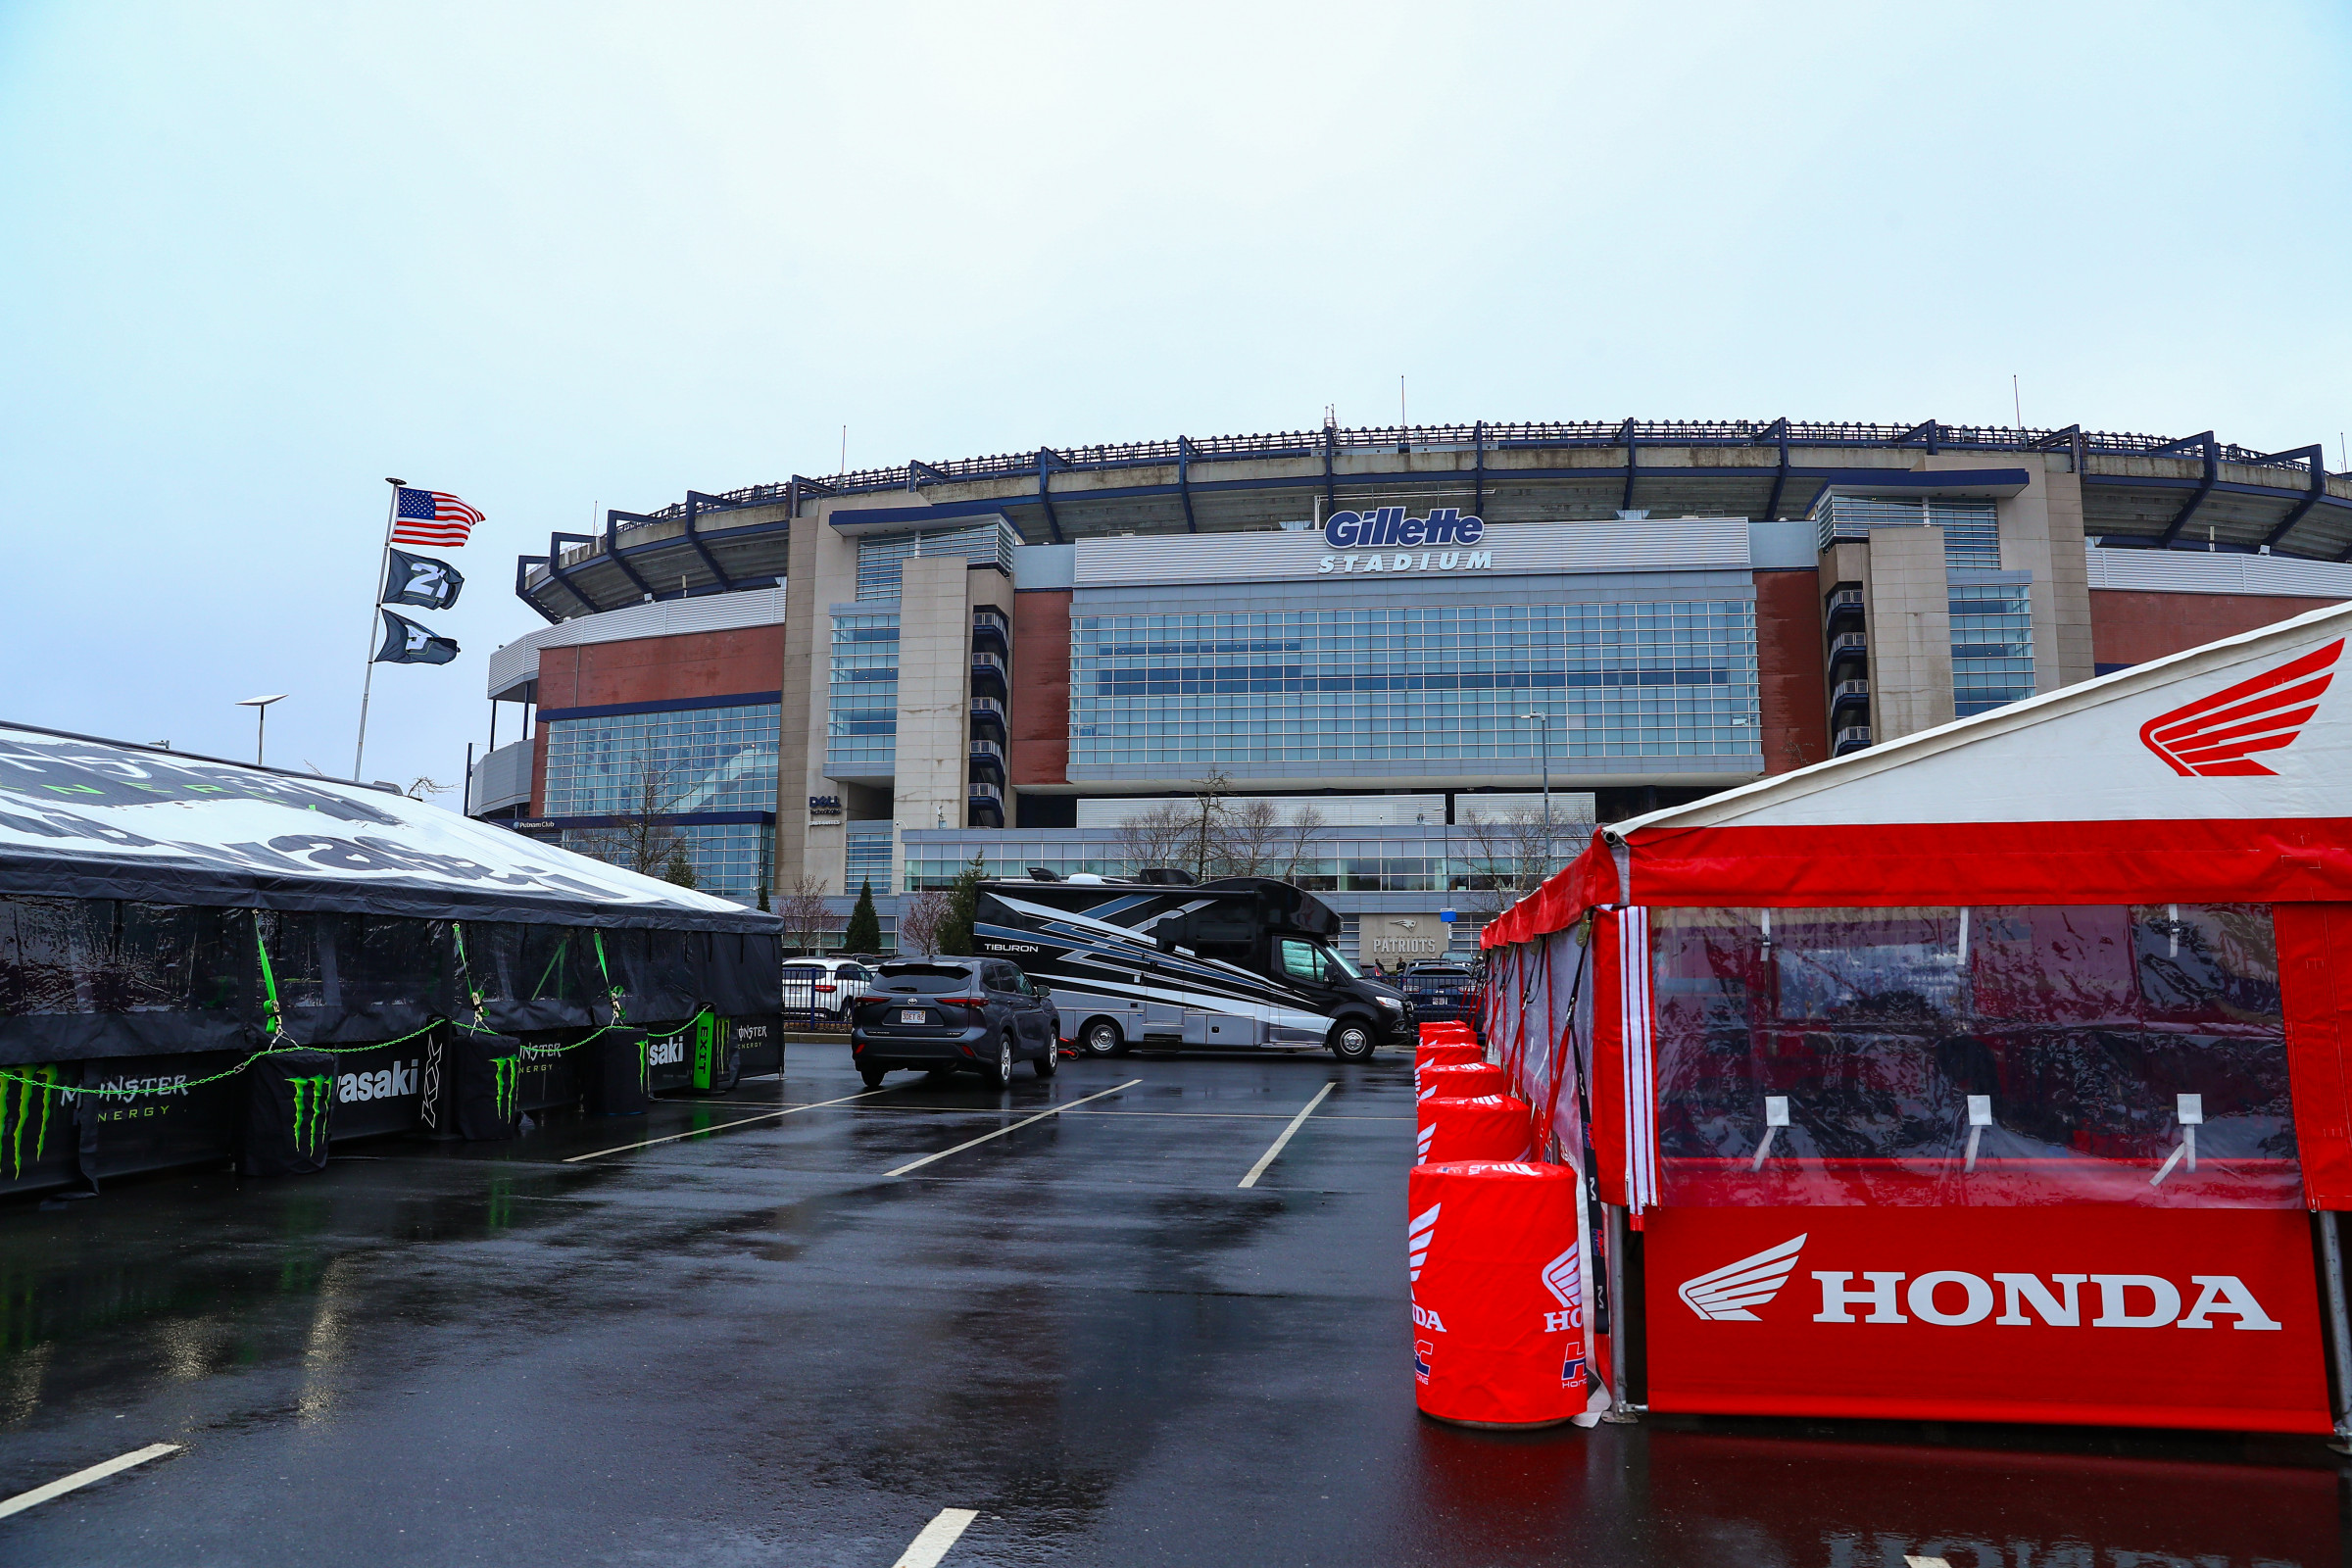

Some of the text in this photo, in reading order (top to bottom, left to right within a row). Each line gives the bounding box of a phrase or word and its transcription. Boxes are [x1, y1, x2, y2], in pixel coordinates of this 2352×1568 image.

[1324, 506, 1485, 549] Gillette
[1317, 551, 1493, 573] STADIUM
[809, 796, 842, 808] DELL
[984, 943, 1039, 953] TIBURON
[1373, 939, 1437, 953] PATRIOTS
[649, 1035, 684, 1066] saki
[698, 1026, 709, 1075] EXIT
[60, 1075, 189, 1108] MNSTER
[336, 1058, 418, 1103] asaki
[1811, 1270, 2282, 1330] HONDA
